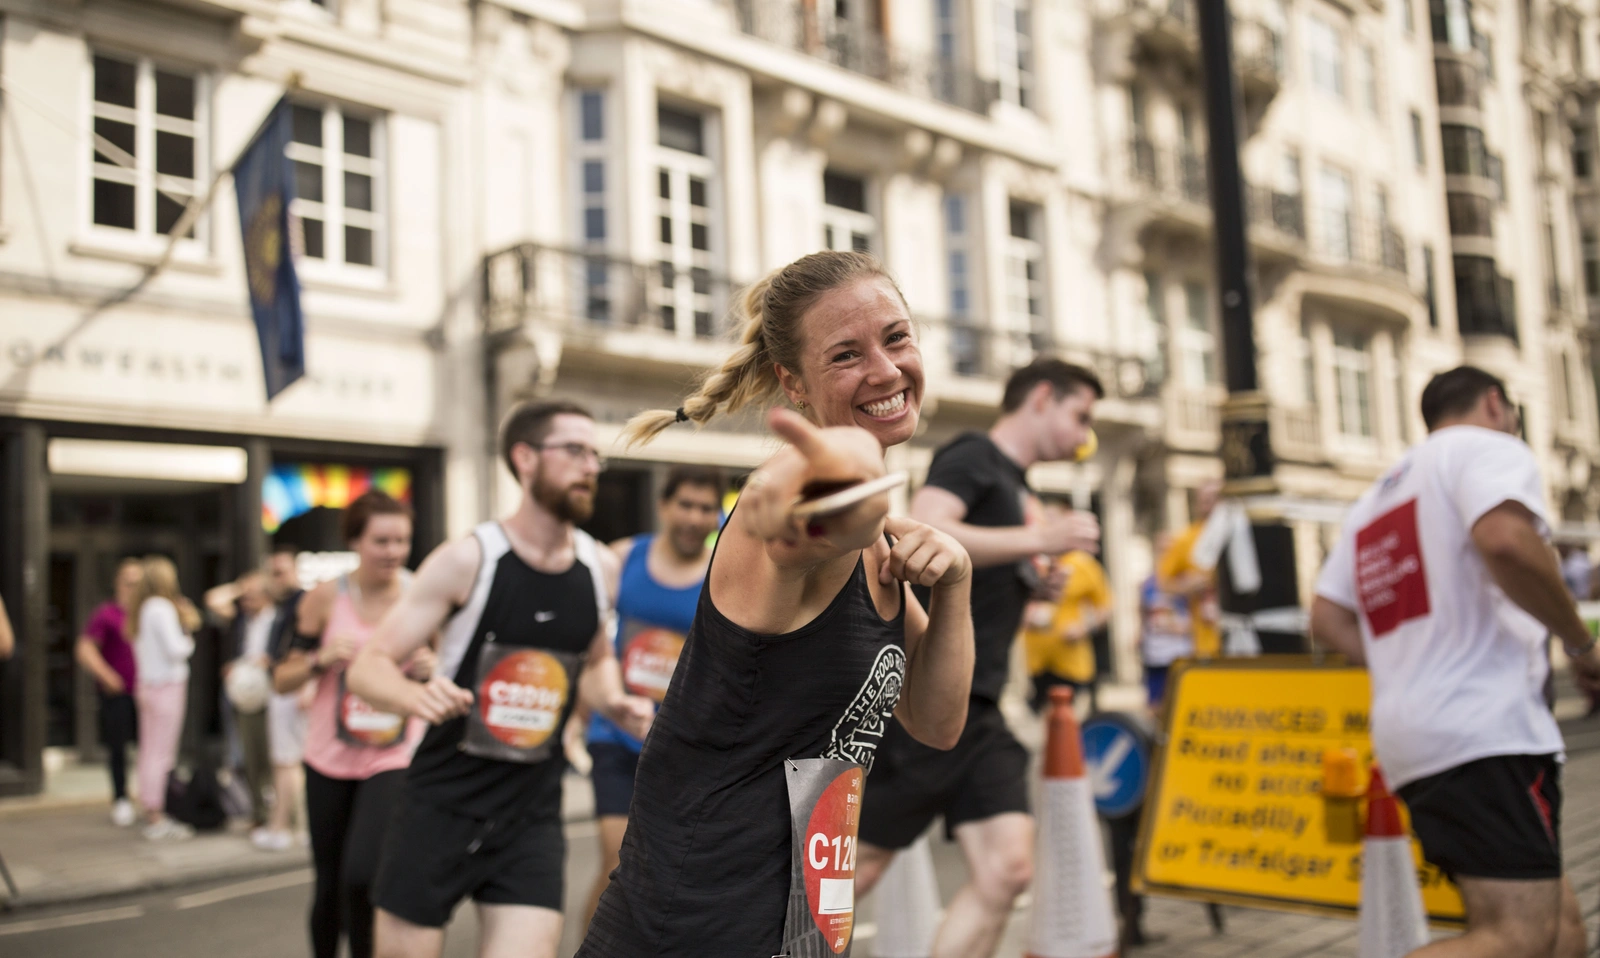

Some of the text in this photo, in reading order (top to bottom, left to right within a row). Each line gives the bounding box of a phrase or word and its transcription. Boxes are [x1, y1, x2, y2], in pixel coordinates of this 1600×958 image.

[847, 685, 877, 722] THE
[875, 653, 895, 686] FOOD
[1178, 735, 1249, 761] Road
[1172, 800, 1310, 836] Piccadilly
[1198, 840, 1335, 878] Trafalgar
